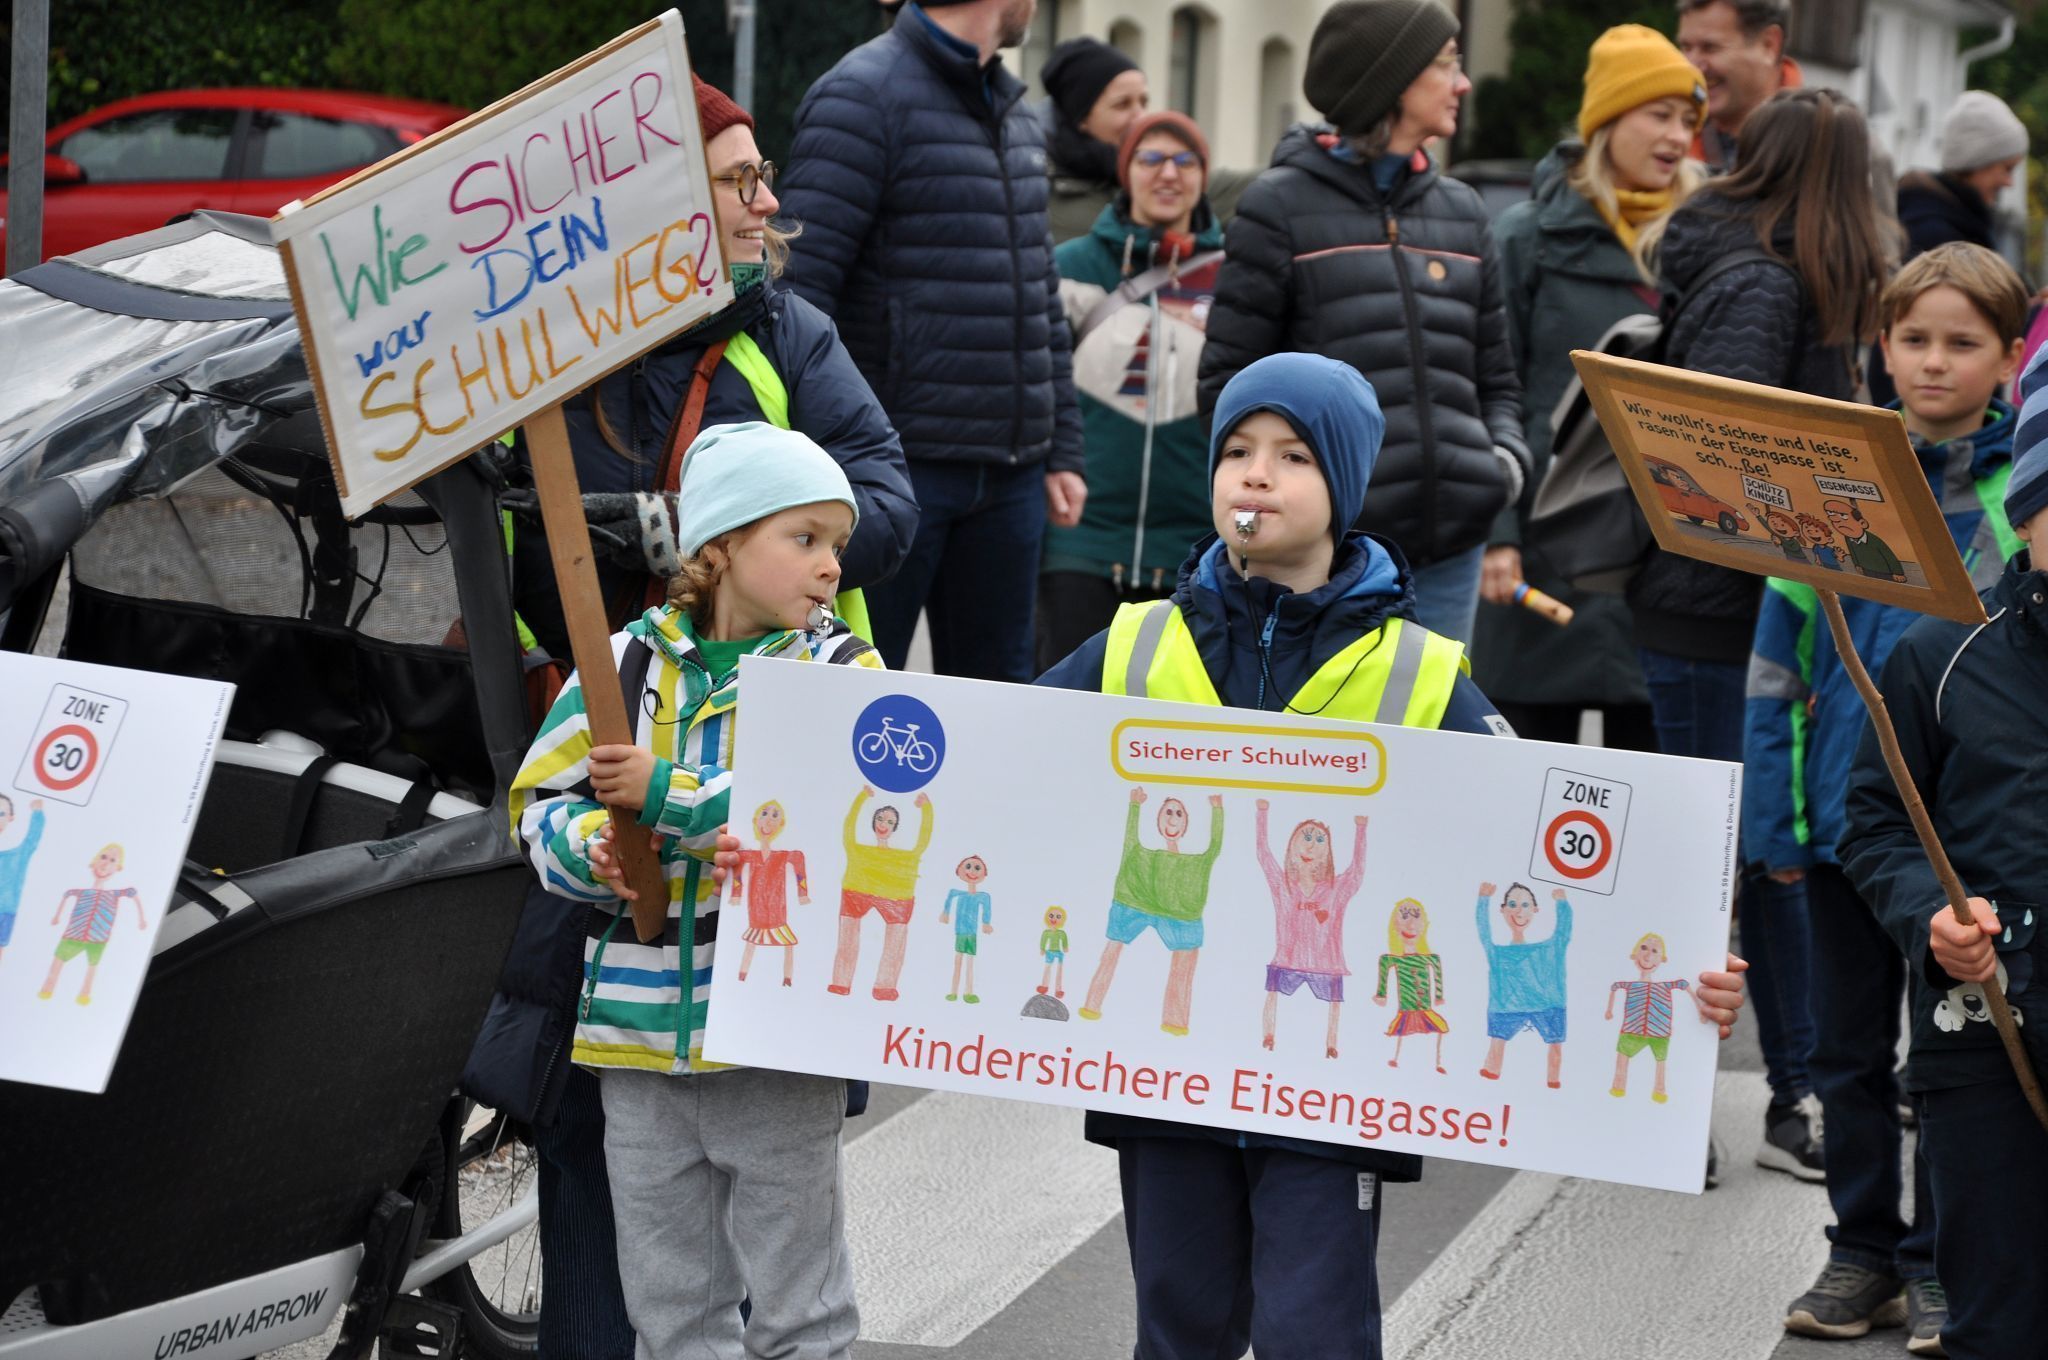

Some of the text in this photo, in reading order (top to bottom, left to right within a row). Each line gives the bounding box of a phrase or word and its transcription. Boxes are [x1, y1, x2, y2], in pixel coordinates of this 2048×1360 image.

[319, 72, 680, 320] Wie SICHER
[355, 197, 608, 377] war DEIN
[1622, 399, 1859, 462] Wir wolln's sicher und leise,
[1638, 420, 1845, 474] rasen in der Eisengasse ist
[1745, 478, 1783, 498] SCHÜTZ
[1747, 488, 1785, 506] KINDER
[1819, 480, 1876, 496] EISENGASSE
[63, 696, 109, 724] ZONE
[48, 743, 83, 771] 30
[1129, 740, 1367, 772] Sicherer Schulweg!
[1562, 780, 1612, 809] ZONE
[1560, 830, 1595, 859] 30
[882, 1024, 1512, 1148] Kindersichere Eisengasse!
[155, 1287, 328, 1360] URBAN ARROW
